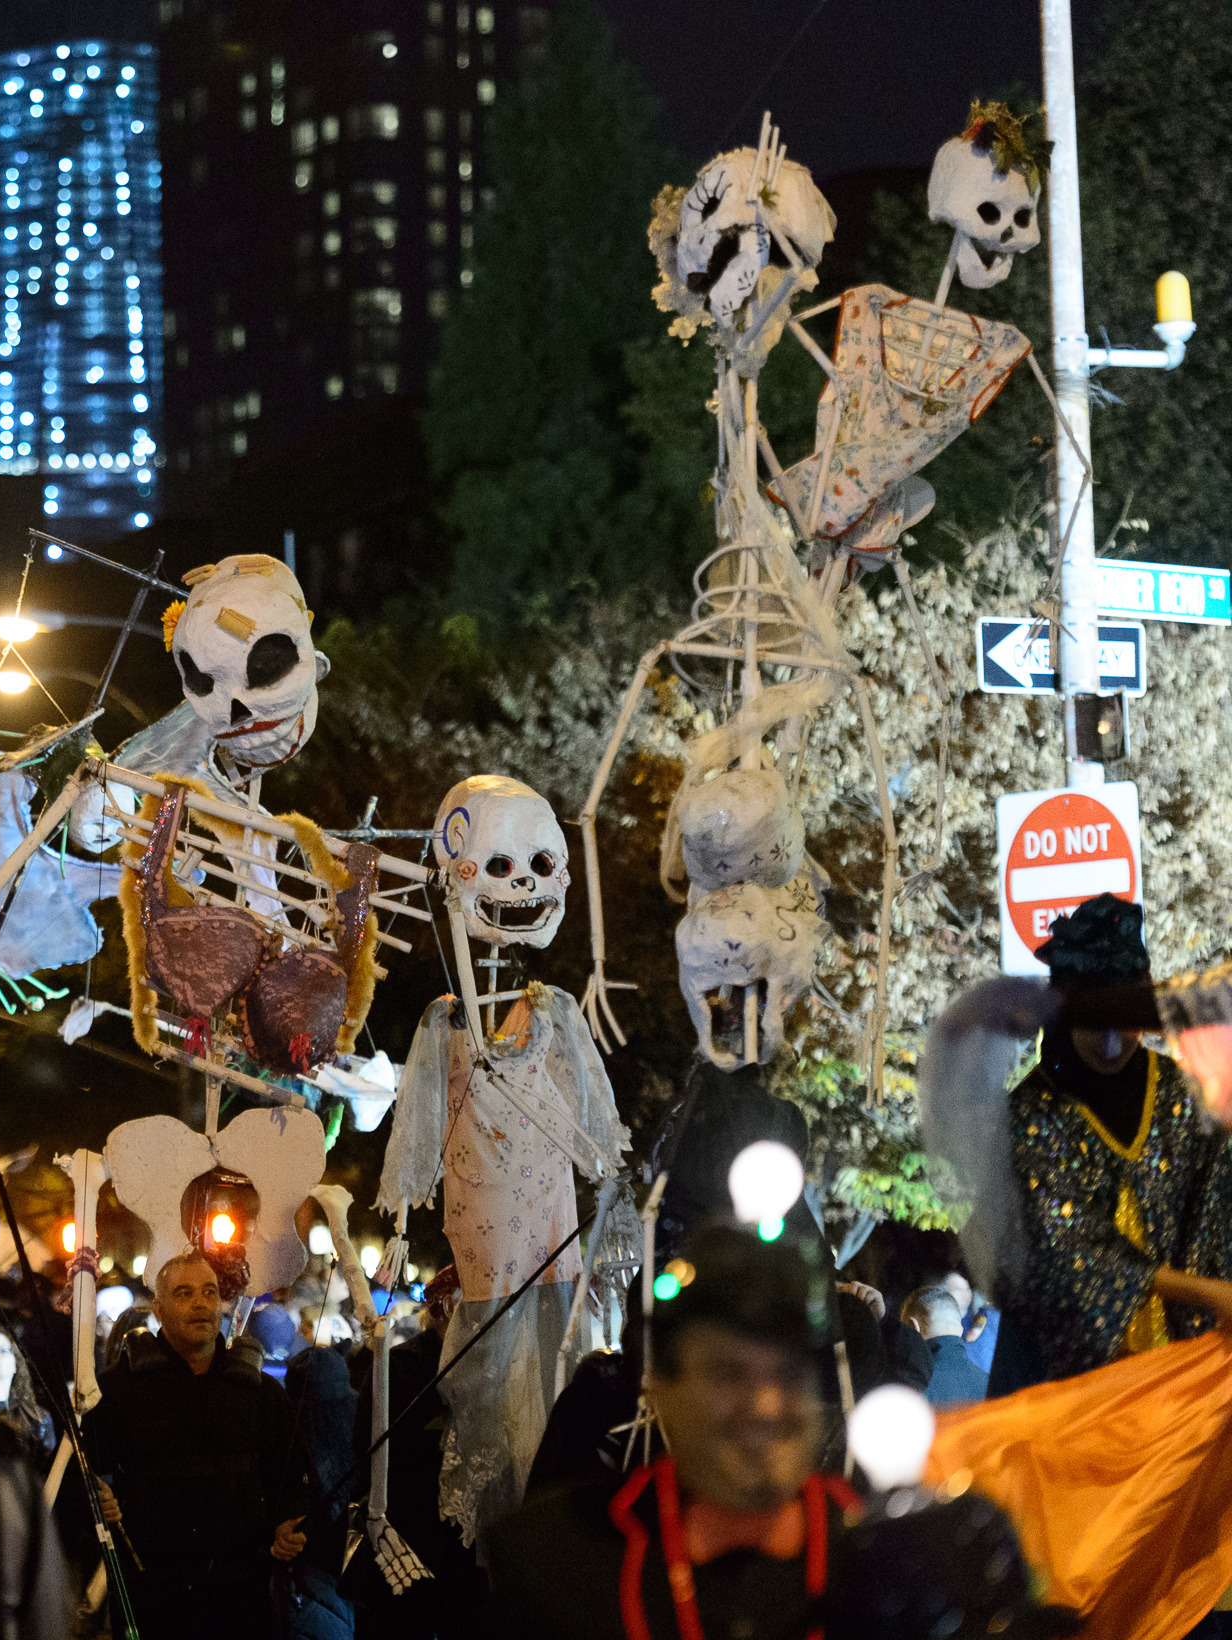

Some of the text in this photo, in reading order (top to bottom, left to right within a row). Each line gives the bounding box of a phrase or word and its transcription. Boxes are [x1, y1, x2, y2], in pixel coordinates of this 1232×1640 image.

[1159, 572, 1205, 616] DEMO
[1099, 647, 1124, 671] AY
[1024, 823, 1111, 859] DO NOT
